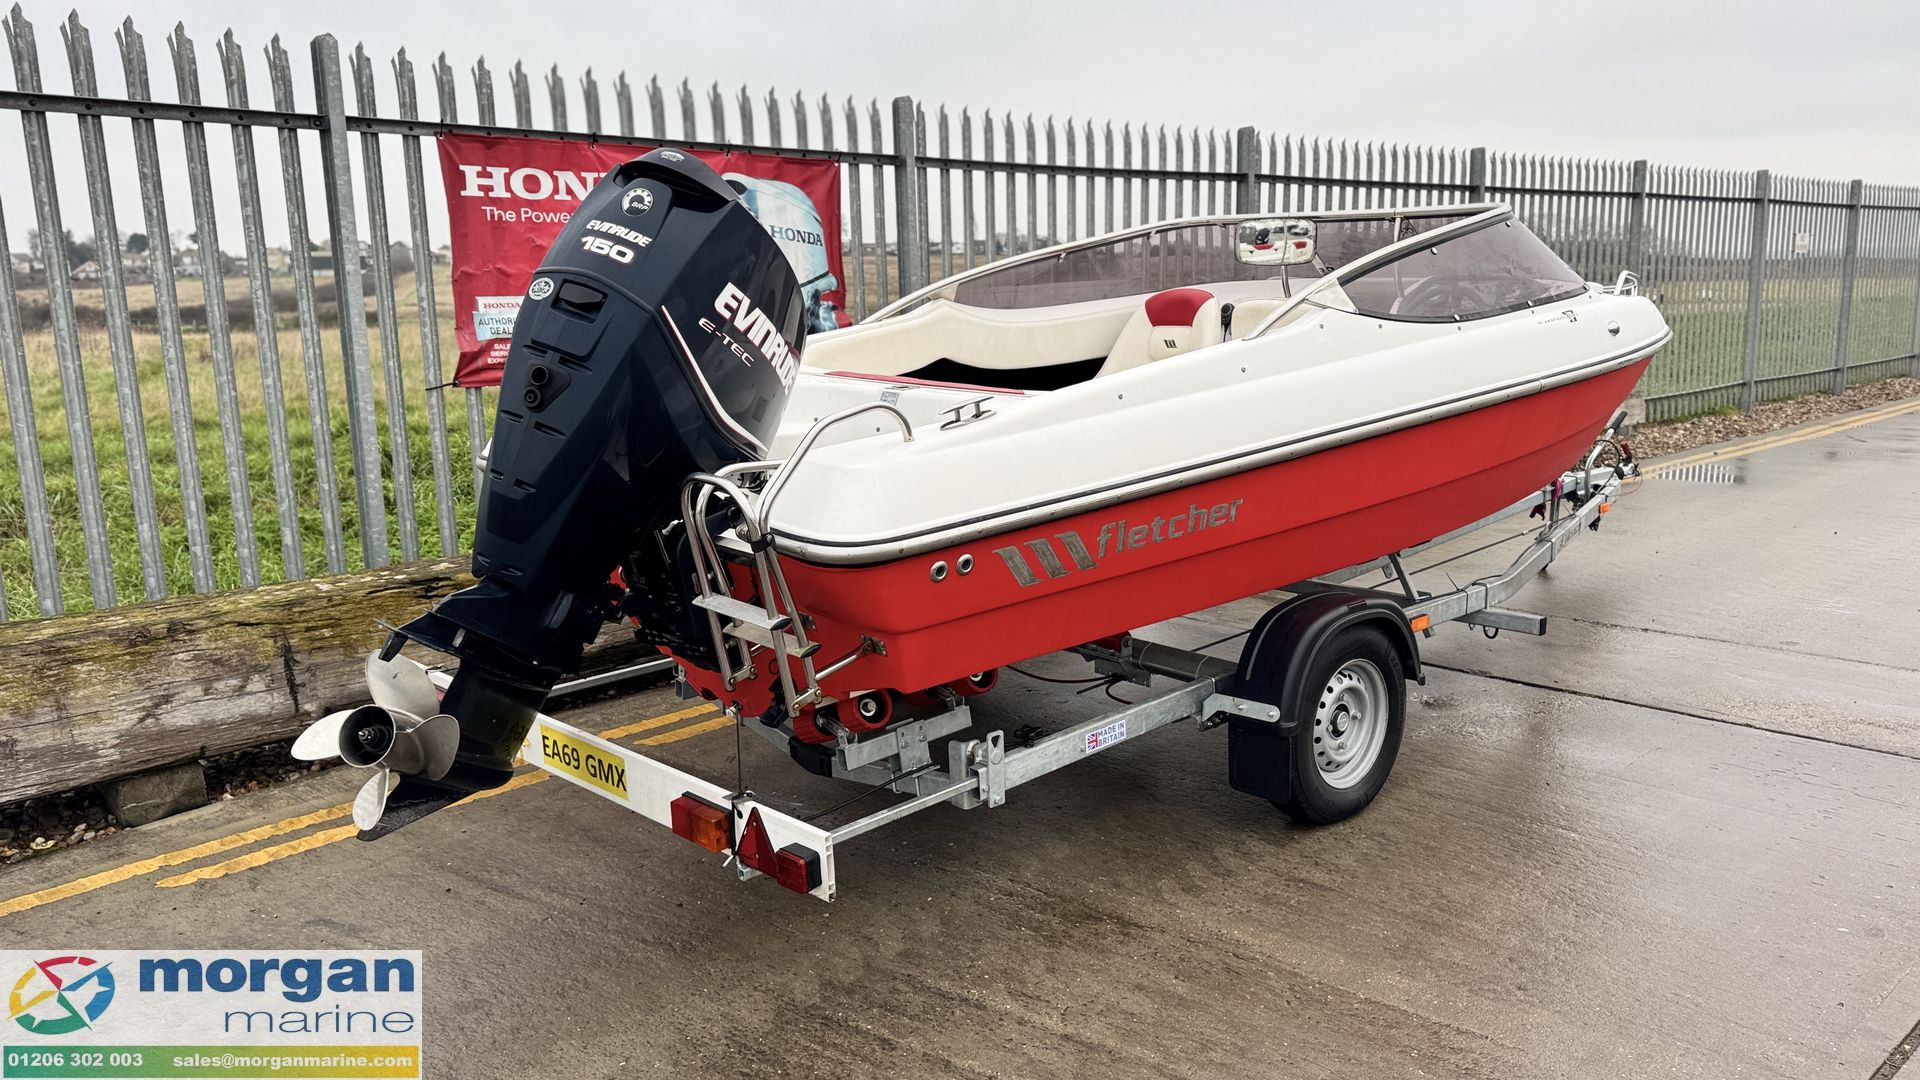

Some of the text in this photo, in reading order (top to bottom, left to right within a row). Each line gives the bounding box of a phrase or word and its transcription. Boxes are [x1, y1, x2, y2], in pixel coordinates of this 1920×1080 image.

[459, 164, 608, 201] HON
[481, 206, 574, 223] The Powe
[631, 201, 649, 210] BRP
[586, 219, 653, 248] EVINRUDE
[768, 224, 824, 247] HONDA
[698, 317, 755, 368] E-TEC
[1097, 498, 1244, 559] fletcher
[1098, 726, 1117, 737] MADE
[1098, 731, 1125, 746] BRITAIN
[541, 734, 628, 792] EA69 GMX
